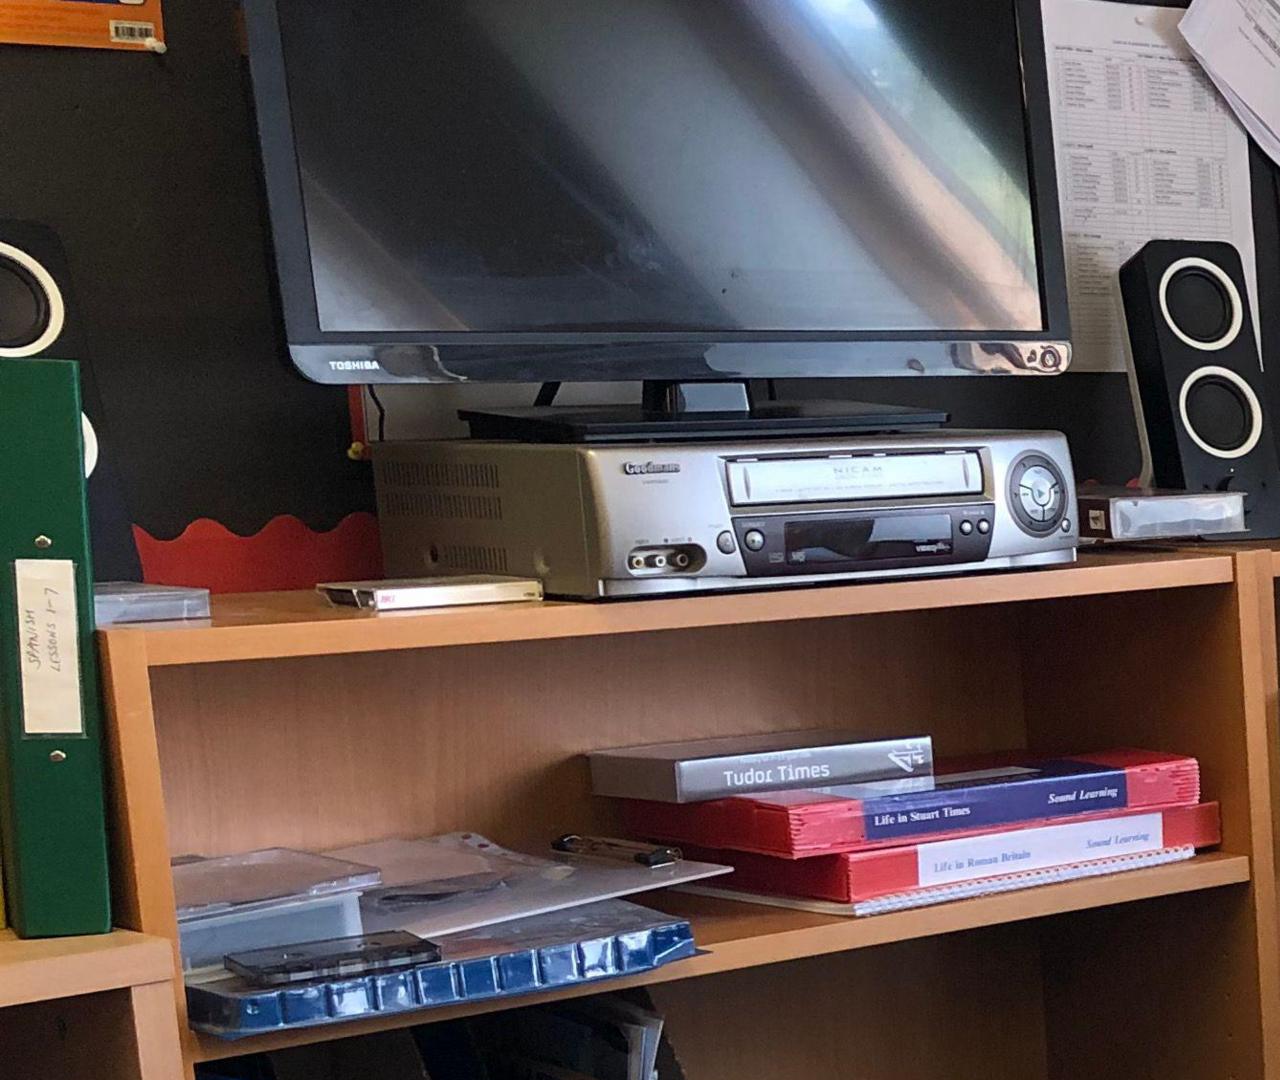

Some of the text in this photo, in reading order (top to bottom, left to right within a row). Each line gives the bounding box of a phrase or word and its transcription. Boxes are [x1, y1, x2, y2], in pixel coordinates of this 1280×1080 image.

[329, 360, 380, 370] TOSHIBA
[624, 461, 681, 475] Goodmans
[25, 609, 42, 671] SPANISH
[46, 622, 62, 672] LESSONS
[723, 763, 830, 786] Tudor Times
[1048, 786, 1119, 804] Sound Learning
[874, 806, 971, 827] Life in Stuart Times
[1086, 831, 1150, 849] Sound Learning
[934, 850, 1032, 873] Life in Roman Britain
